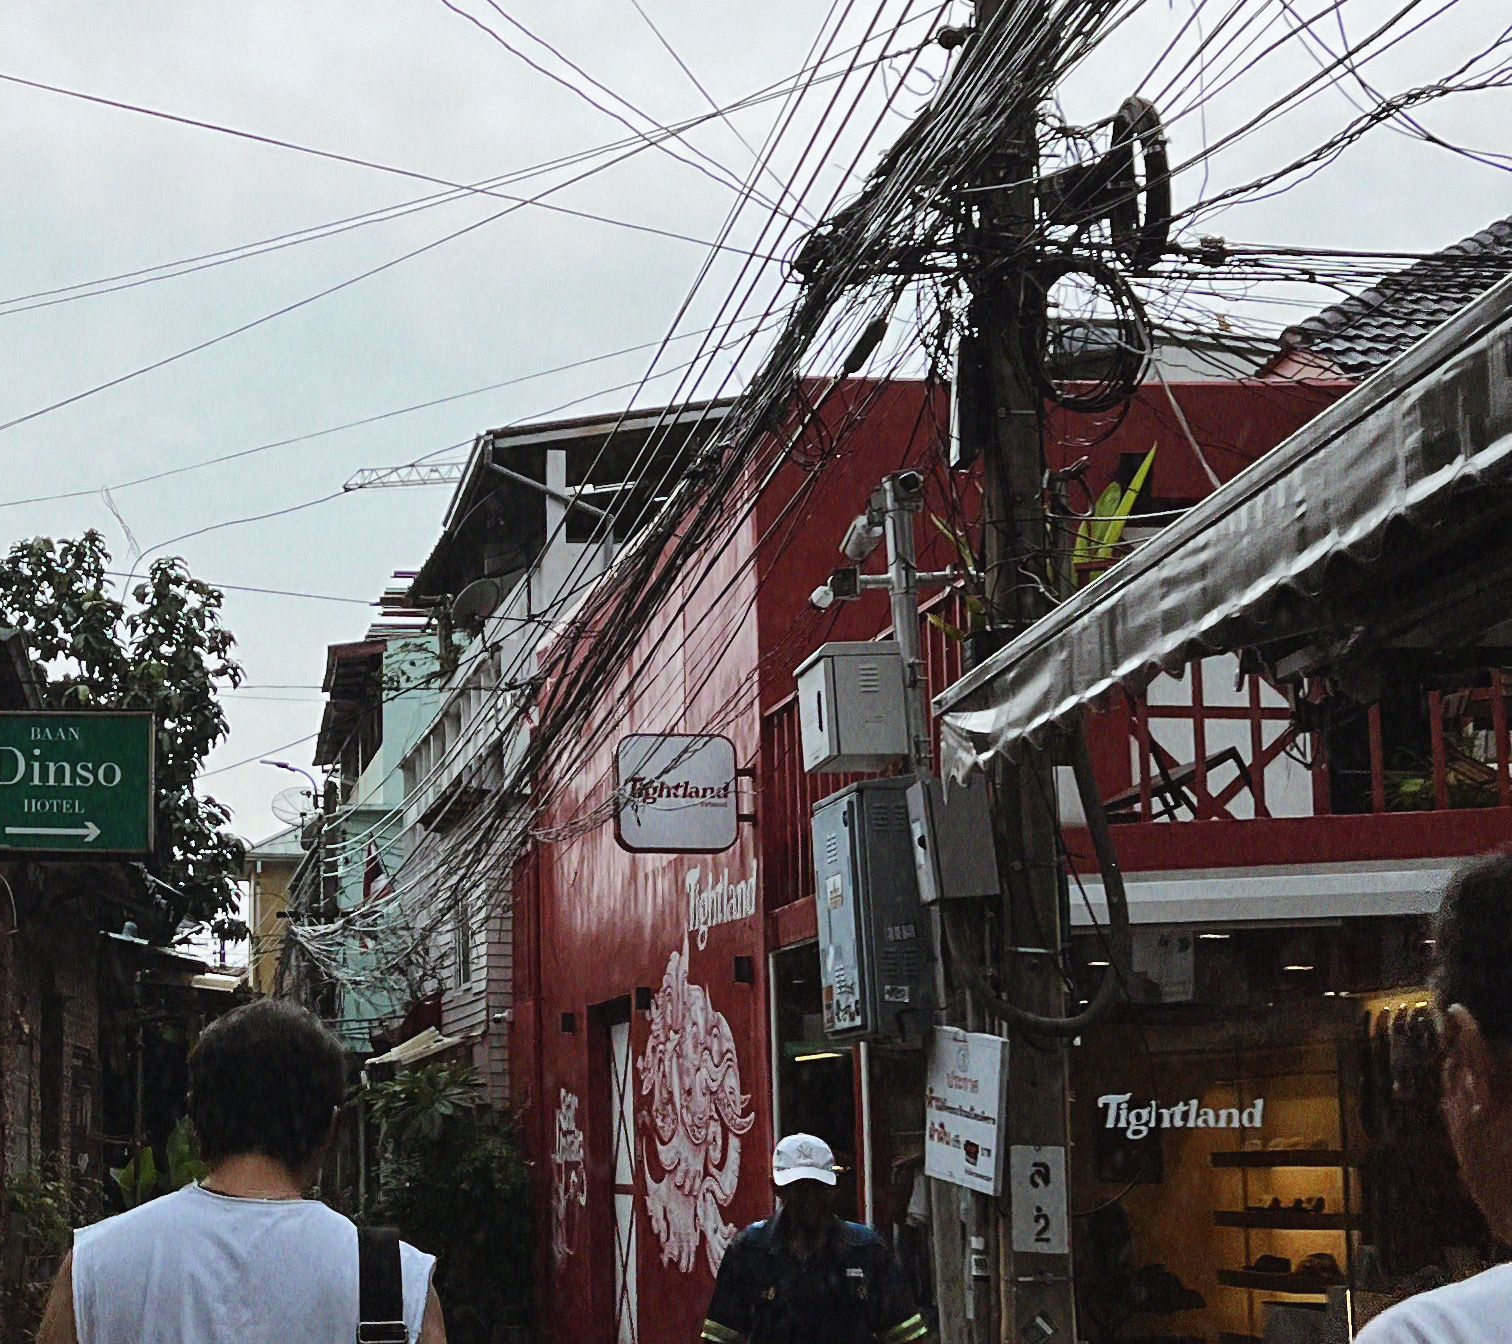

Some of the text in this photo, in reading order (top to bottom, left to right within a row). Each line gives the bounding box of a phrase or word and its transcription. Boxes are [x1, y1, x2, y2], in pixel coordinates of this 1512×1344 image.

[30, 726, 80, 741] BAAN
[24, 798, 85, 814] HOTEL
[685, 858, 758, 951] Tightland
[1096, 1092, 1264, 1140] Tightland
